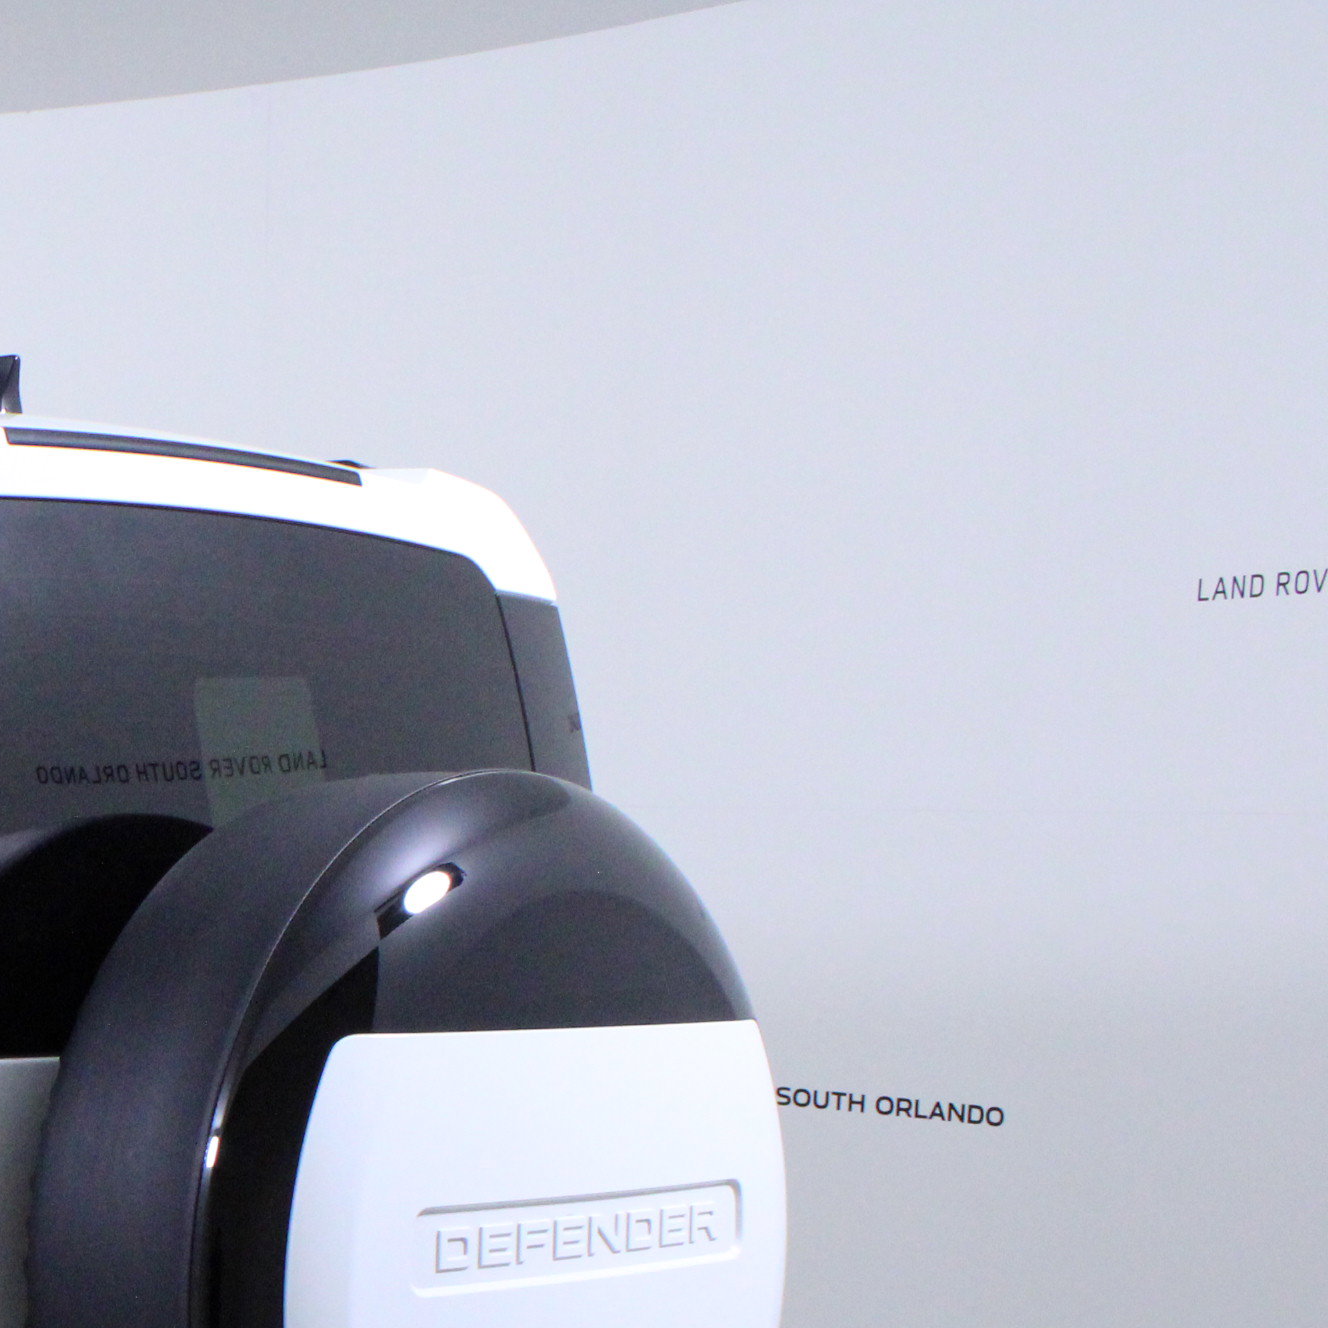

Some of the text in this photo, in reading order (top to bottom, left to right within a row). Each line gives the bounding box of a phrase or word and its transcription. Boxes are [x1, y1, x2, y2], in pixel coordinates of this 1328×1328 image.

[1197, 573, 1264, 601] LAND
[776, 1086, 1004, 1127] SOUTH ORLANDO
[435, 1201, 718, 1274] DEFENDER
